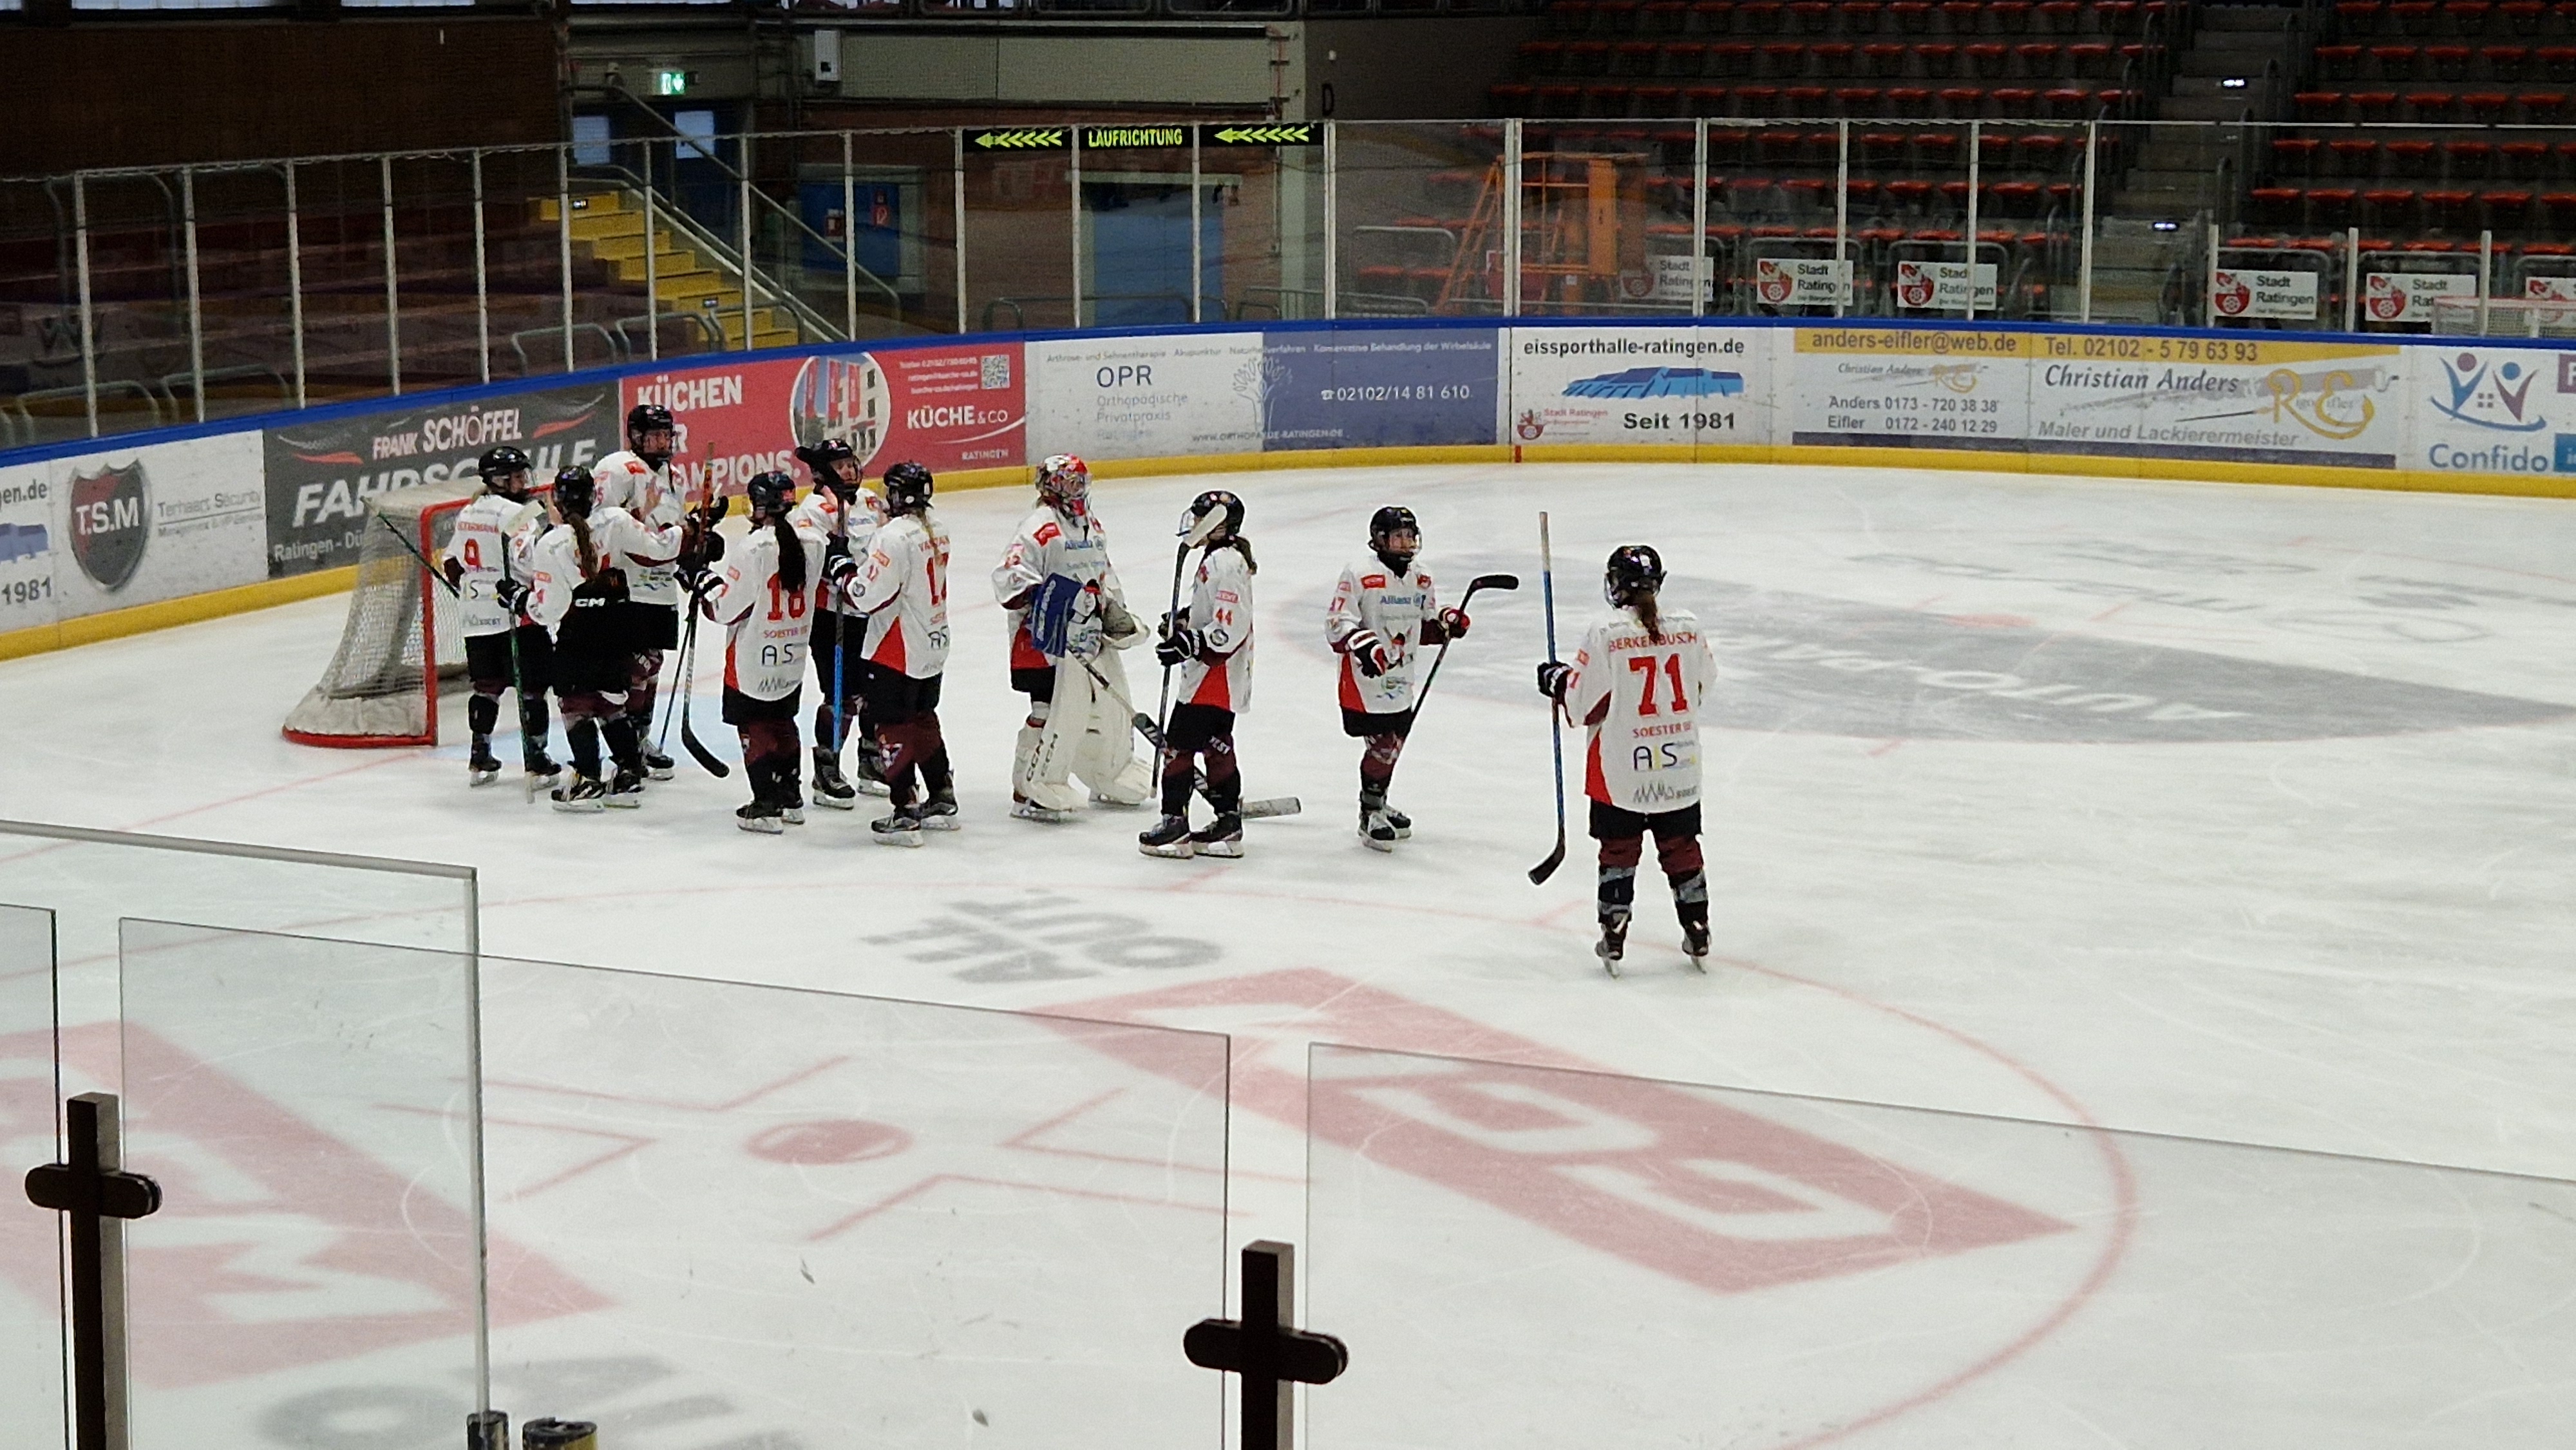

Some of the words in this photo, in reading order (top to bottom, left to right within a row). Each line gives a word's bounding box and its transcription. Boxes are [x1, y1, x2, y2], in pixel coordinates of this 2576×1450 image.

[1088, 129, 1182, 147] LAUFRICHTUNG
[1660, 260, 1690, 271] Stadt
[1797, 263, 1828, 275] Stadt
[1940, 267, 1967, 278] Stad
[2257, 275, 2291, 287] Stadt
[2412, 279, 2447, 290] Stadt
[2256, 291, 2314, 306] Ratingen
[1524, 338, 1745, 358] eissporthalle-ratingen.de
[1812, 331, 2016, 354] anders-eifler@web.de
[2045, 337, 2076, 356] Tel.
[2084, 338, 2141, 358] 02102
[2159, 339, 2172, 358] 5
[2176, 339, 2199, 359] 79
[2206, 341, 2228, 361] 63
[2235, 342, 2257, 361] 93
[1096, 365, 1152, 388] OPR
[2045, 364, 2148, 388] Christian
[2157, 368, 2240, 393] Anders
[638, 374, 742, 412] KÜCHEN
[1337, 385, 1410, 402] 02102/14
[1416, 385, 1434, 400] 81
[1441, 385, 1471, 400] 610
[1829, 395, 1880, 410] Anders
[1885, 396, 1918, 410] 0173
[1932, 397, 1956, 412] 720
[1961, 399, 1976, 413] 38
[1981, 400, 1998, 413] 38
[907, 404, 975, 429] KÜCHE
[977, 411, 987, 424] &
[988, 409, 1009, 423] CO
[1624, 412, 1670, 430] Seit
[1679, 412, 1734, 430] 1981
[1828, 415, 1865, 429] Eifler
[1885, 417, 1918, 430] 0172
[1932, 418, 1956, 432] 240
[1962, 419, 1976, 433] 12
[1981, 420, 1998, 433] 29
[372, 432, 418, 460] FRANK
[422, 406, 522, 453] SCHÖFFEL
[2038, 420, 2088, 439] Maler
[2095, 421, 2131, 439] und
[2137, 423, 2300, 447] Lackierermeister
[2429, 443, 2548, 473] Confido
[76, 496, 140, 536] T.S.M
[274, 537, 334, 561] Ratingen
[2, 576, 52, 605] 1981
[1215, 607, 1233, 626] 44
[1628, 653, 1689, 717] 71
